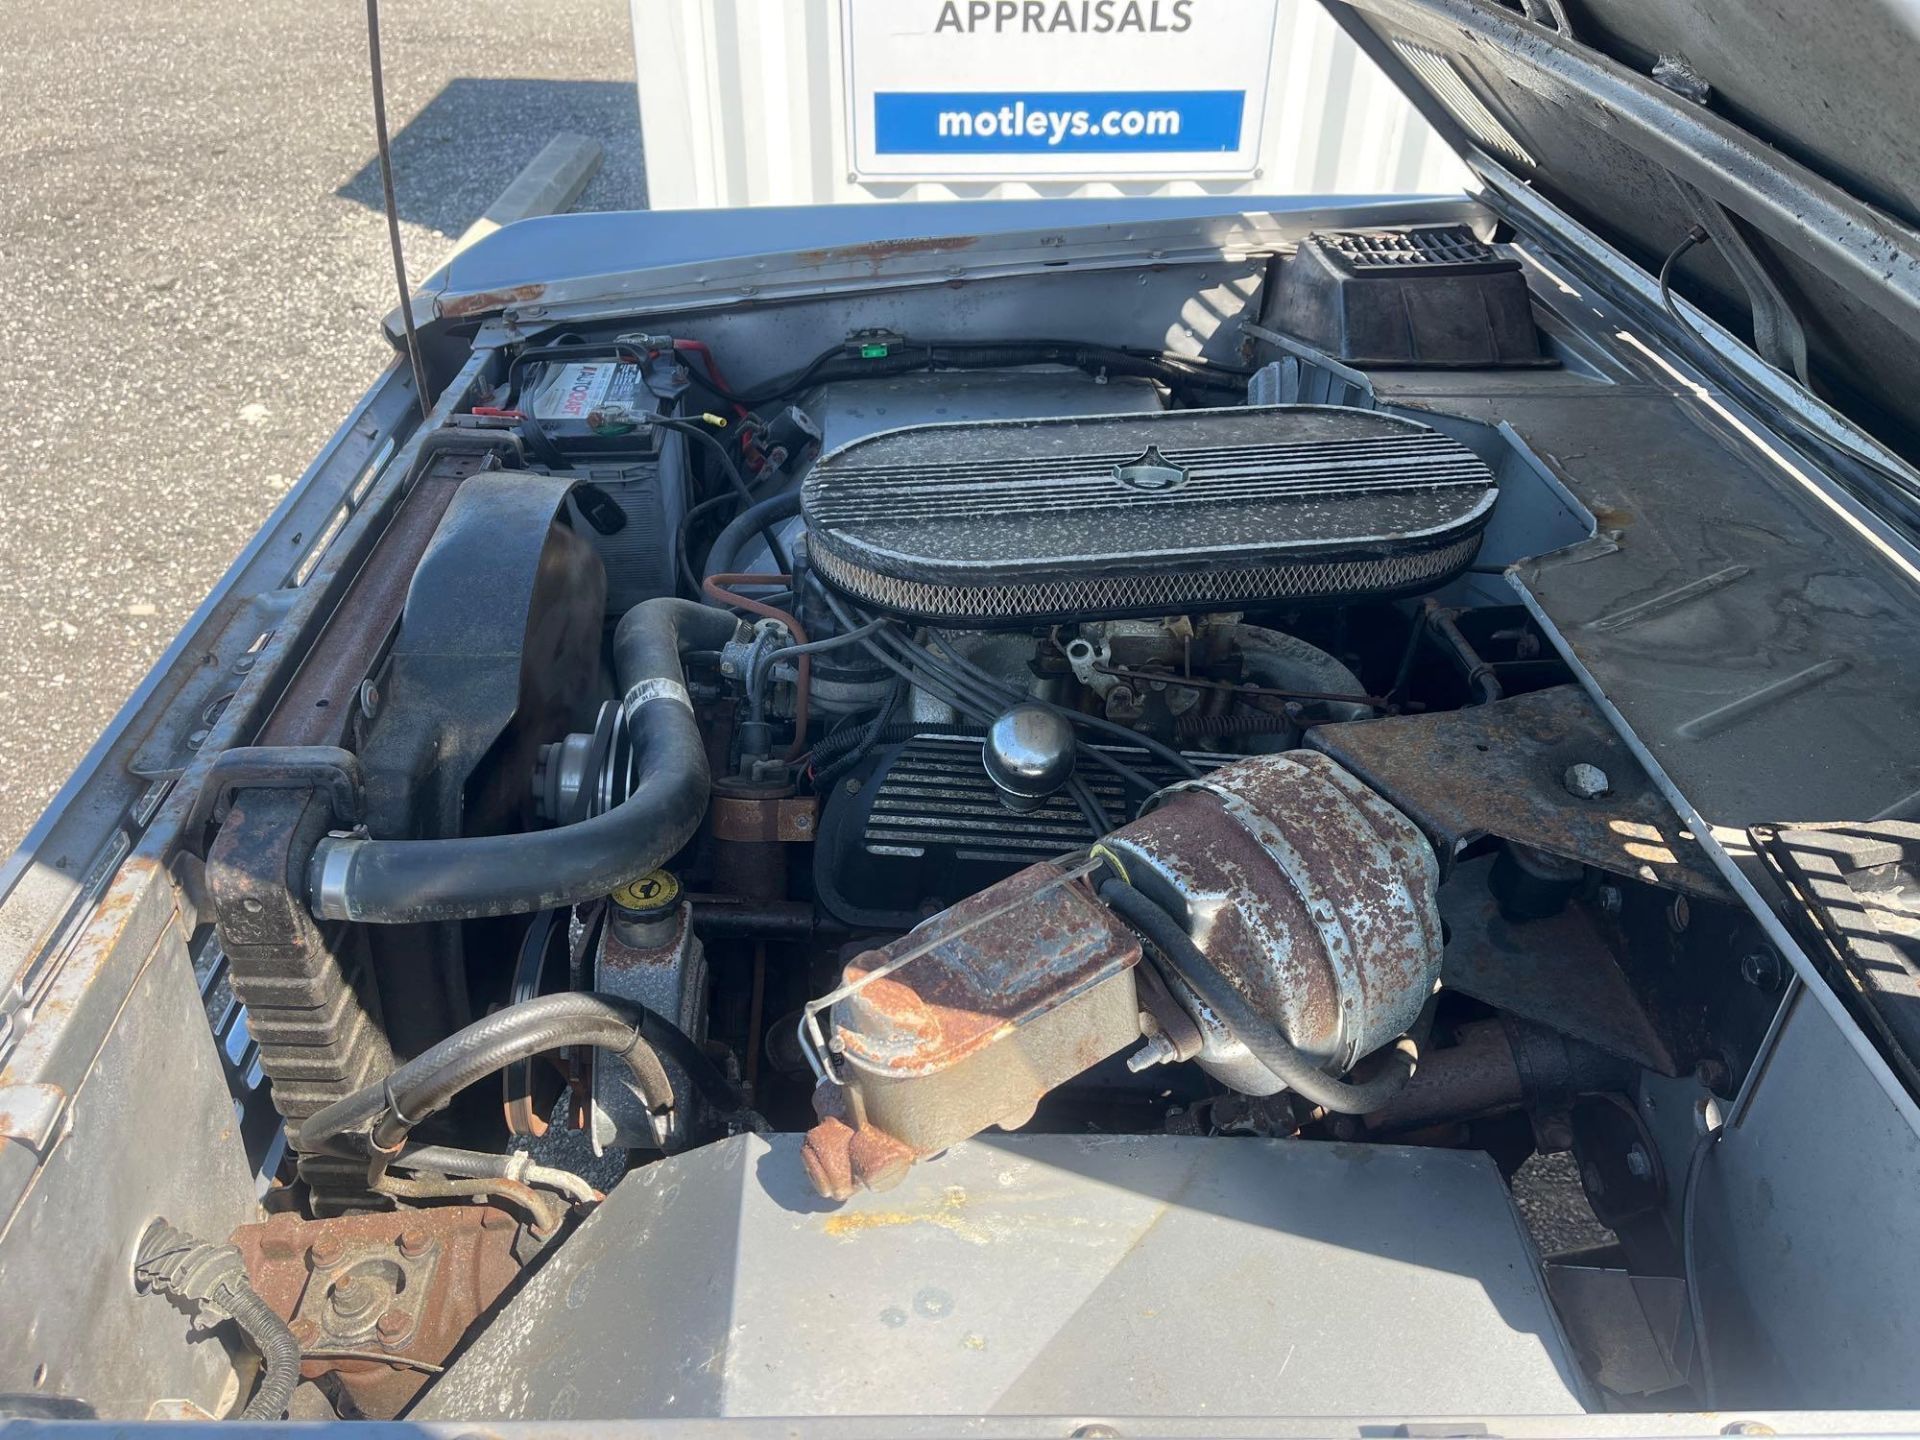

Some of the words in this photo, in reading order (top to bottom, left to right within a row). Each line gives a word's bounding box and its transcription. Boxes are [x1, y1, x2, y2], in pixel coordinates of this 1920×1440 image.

[934, 0, 1193, 33] APPRAISALS
[938, 101, 1181, 145] motleys.com
[561, 369, 597, 416] AUTOCRAFT
